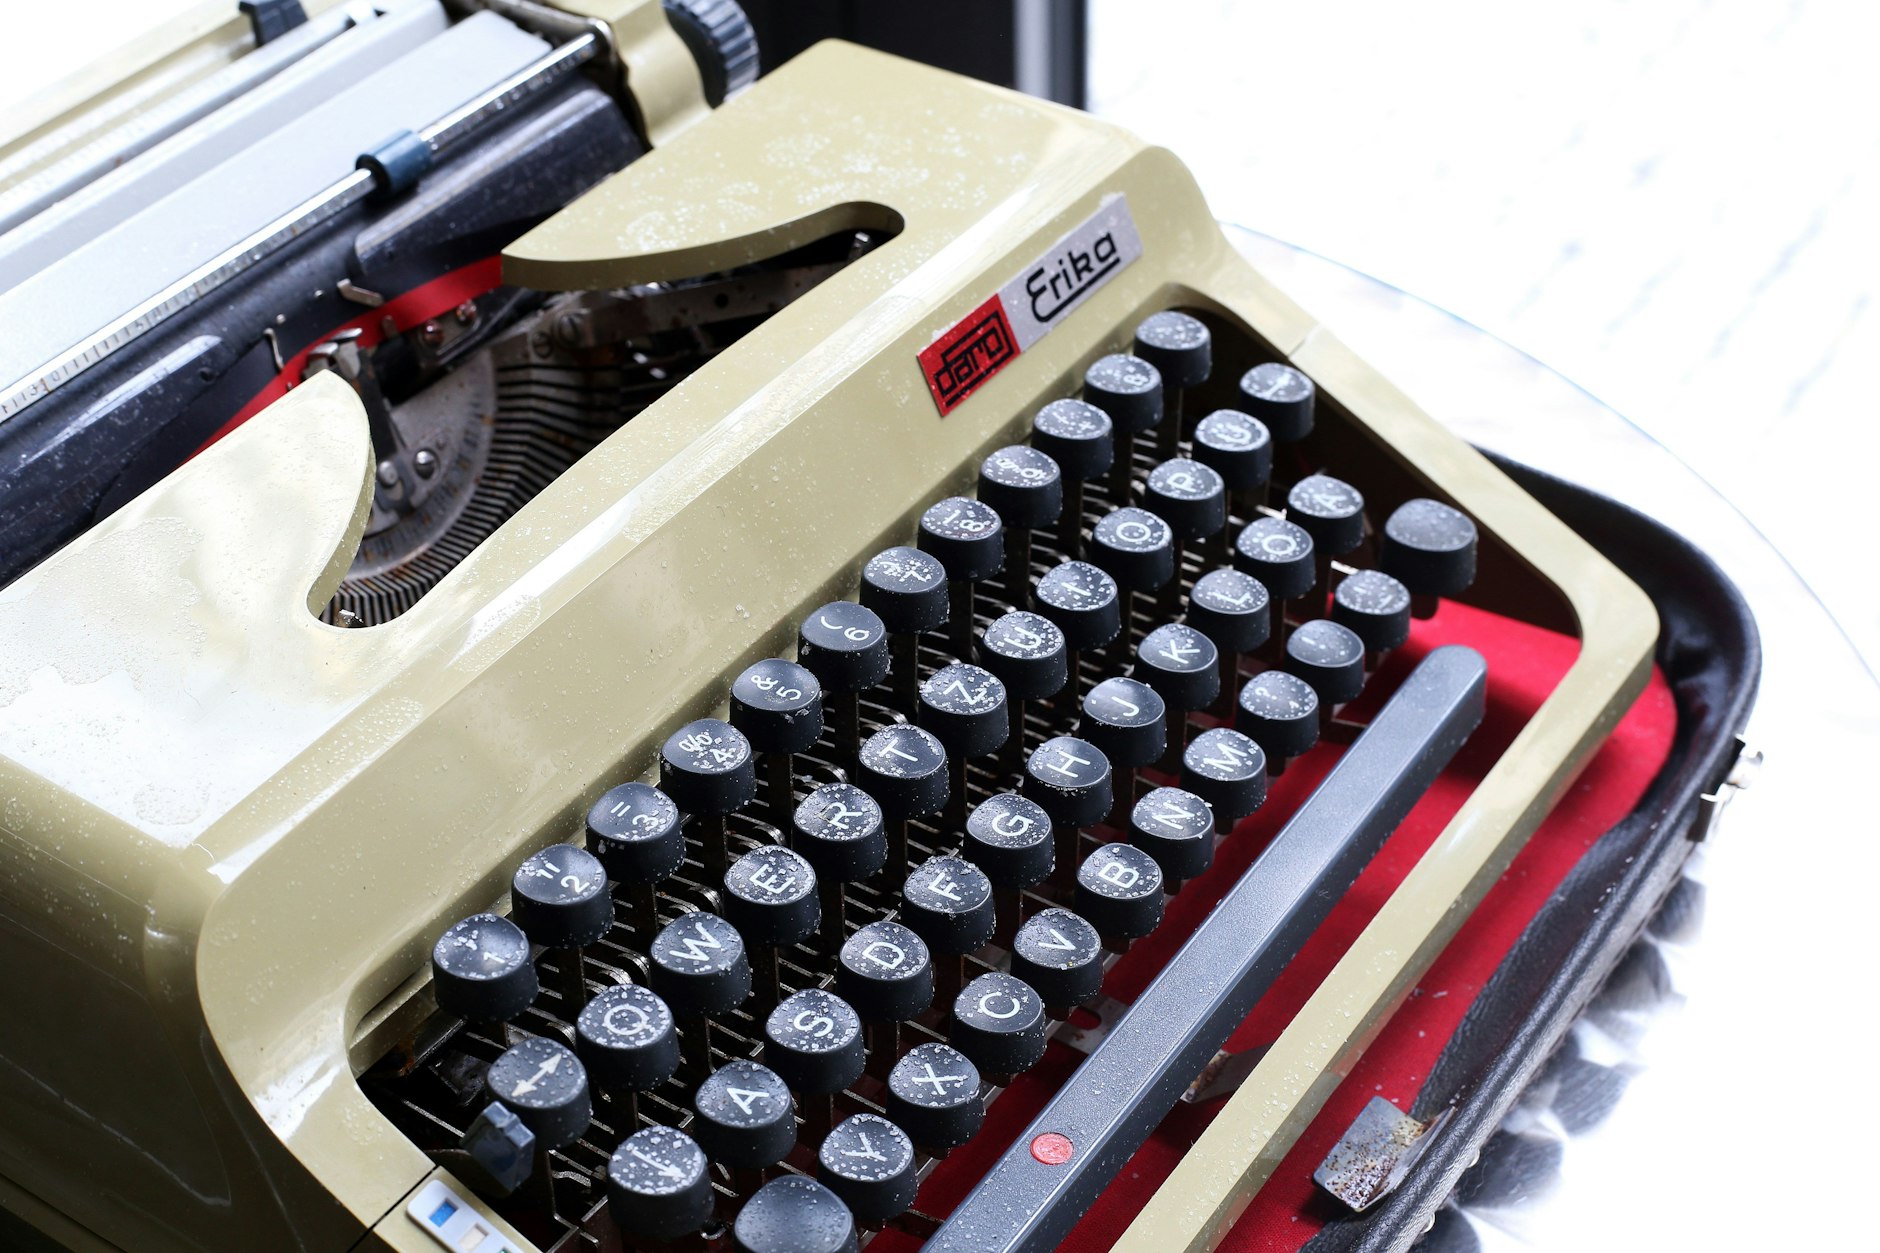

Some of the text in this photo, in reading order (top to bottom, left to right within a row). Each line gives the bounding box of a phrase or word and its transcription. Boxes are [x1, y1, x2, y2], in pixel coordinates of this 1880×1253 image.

[933, 233, 1120, 404] daro Erika
[1168, 472, 1197, 493] P
[959, 519, 984, 532] 8
[1116, 521, 1151, 542] O
[1208, 591, 1251, 605] L
[844, 626, 870, 641] 6
[1003, 626, 1042, 649] U
[1159, 639, 1201, 664] K
[751, 675, 778, 691] &
[776, 687, 802, 701] 5
[942, 680, 988, 705] Z
[1111, 695, 1140, 717] J
[678, 731, 713, 753] %
[878, 737, 918, 763] T
[712, 747, 738, 764] 4
[1046, 751, 1091, 778] H
[1203, 742, 1248, 772] M
[633, 814, 659, 831] 3
[820, 801, 863, 830] R
[991, 812, 1035, 837] G
[1152, 801, 1196, 830] N
[560, 875, 590, 893] 2
[750, 864, 795, 894] E
[928, 872, 962, 901] F
[1099, 862, 1140, 889] B
[668, 921, 722, 962] W
[1038, 928, 1076, 950] V
[483, 952, 505, 964] 1
[862, 942, 905, 970] D
[979, 992, 1021, 1019] C
[794, 1010, 834, 1038] S
[911, 1063, 961, 1096] X
[727, 1087, 770, 1115] A
[842, 1132, 888, 1163] Y
